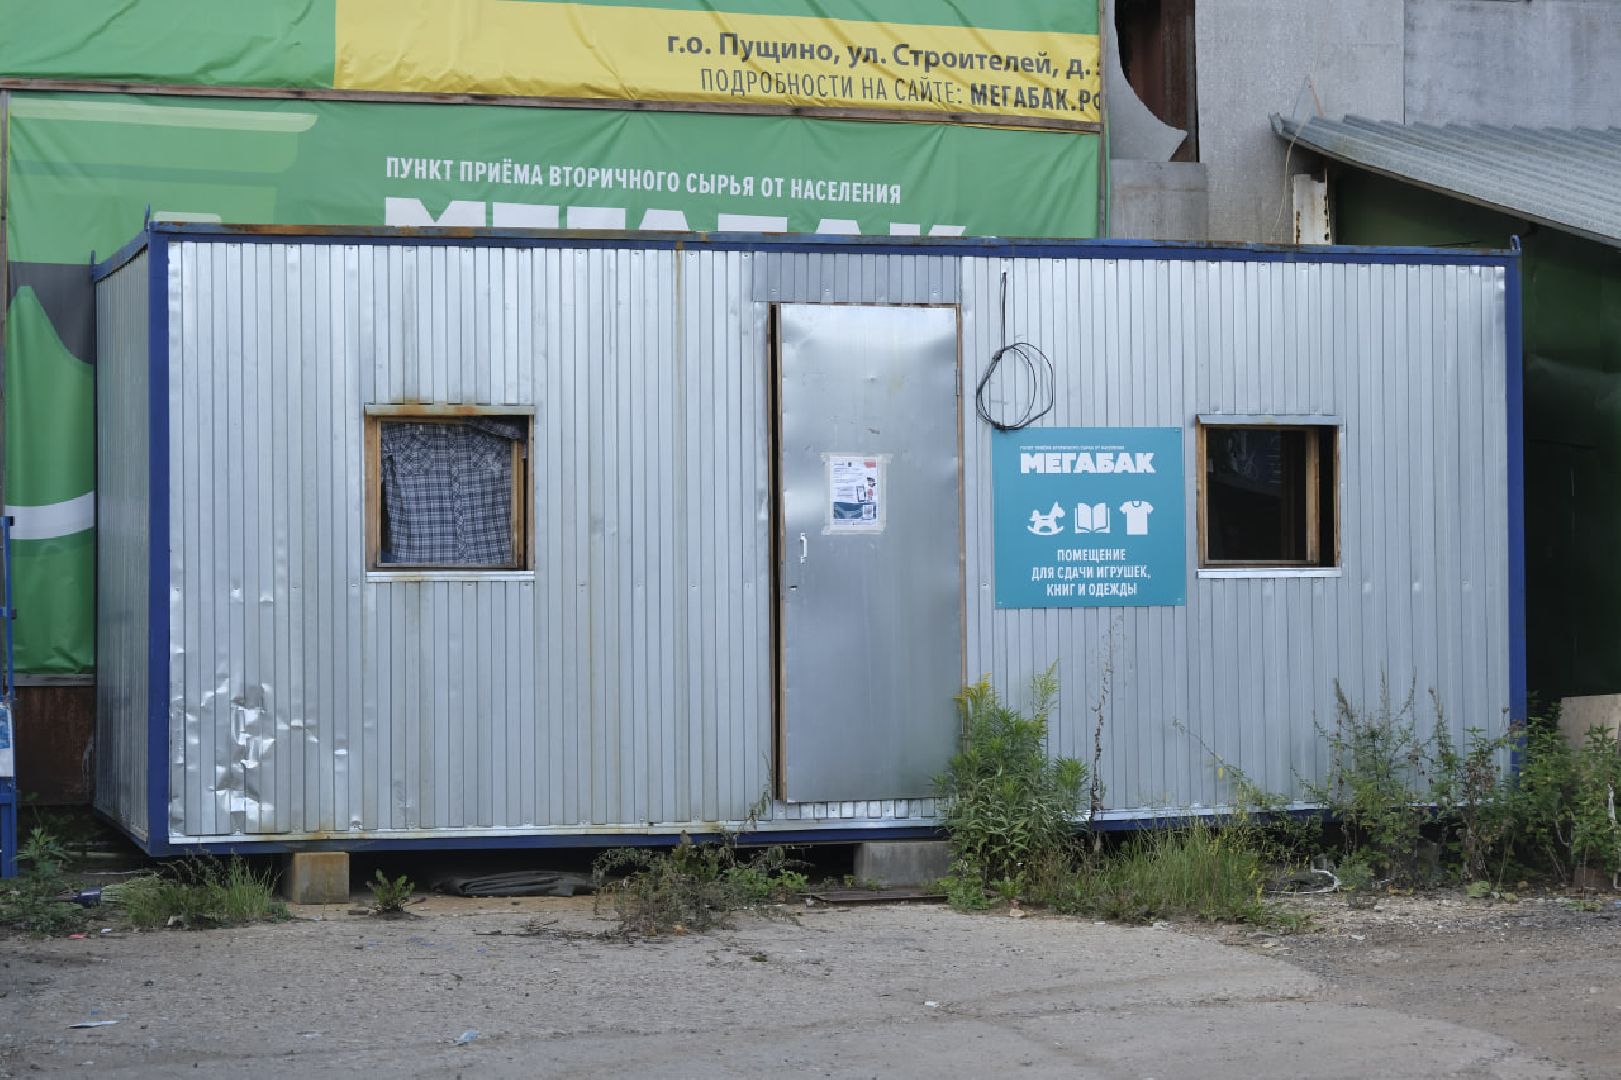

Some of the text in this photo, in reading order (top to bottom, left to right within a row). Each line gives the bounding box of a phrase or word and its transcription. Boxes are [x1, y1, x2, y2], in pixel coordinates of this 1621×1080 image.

[667, 35, 712, 55] г.о.
[719, 32, 840, 65] Пущино,
[847, 45, 887, 68] ул.
[893, 43, 1059, 78] Строителей,
[1066, 58, 1091, 79] д.
[701, 68, 853, 98] ПОДРОБНОСТИ
[861, 77, 888, 101] НА
[894, 76, 963, 104] САЙТЕ:
[385, 156, 901, 204] ПУНКТ ПРИЁМА ВТОРИЧНОГО СЫРЬЯ ОТ НАСЕЛЕНИЯ
[1020, 452, 1157, 474] МЕГАБАК
[1057, 548, 1126, 563] ПОМЕЩЕНИЕ
[1031, 565, 1151, 582] ДЛЯ СДАЧИ ИГРУШЕК,
[1046, 582, 1138, 598] КНИГ И ОДЕЖДЫ
